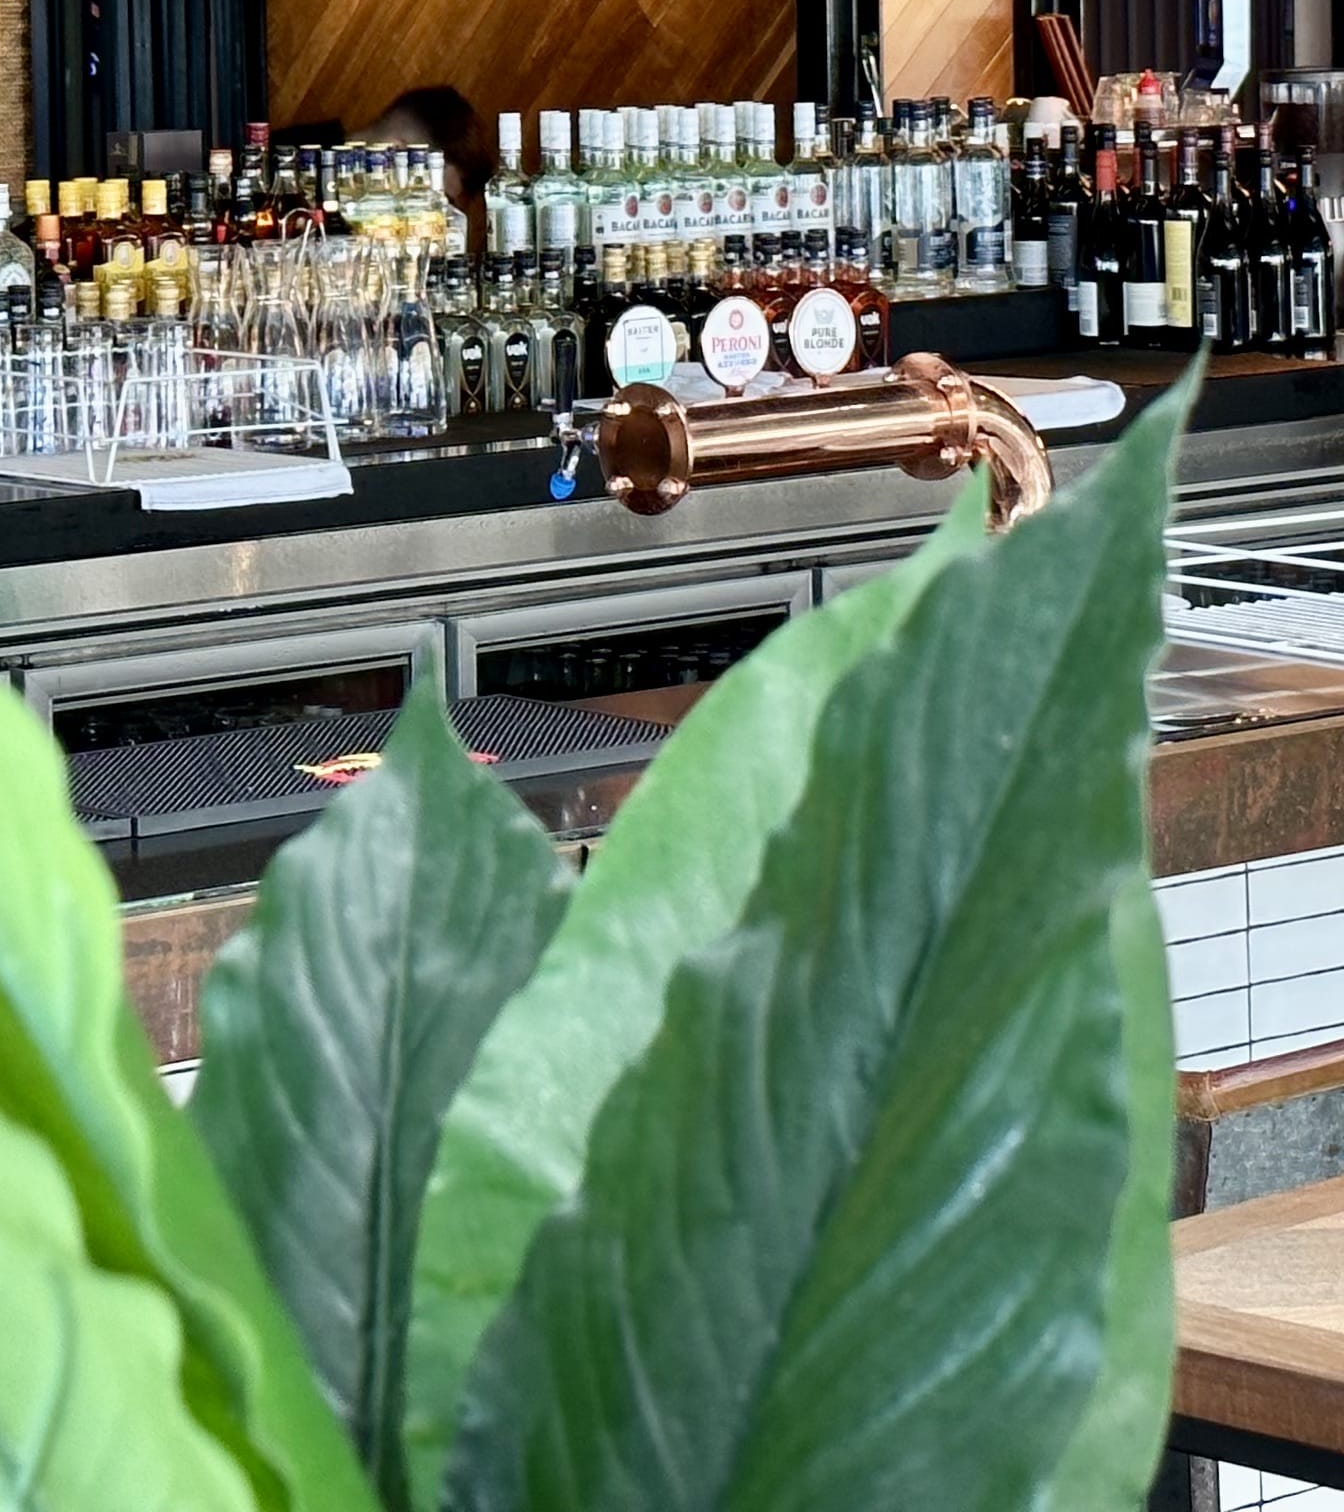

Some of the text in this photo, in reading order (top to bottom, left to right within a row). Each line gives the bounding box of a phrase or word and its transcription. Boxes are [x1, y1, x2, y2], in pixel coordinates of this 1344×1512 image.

[811, 327, 838, 338] PURE
[712, 335, 762, 353] PERONI
[803, 338, 845, 350] BLONDE
